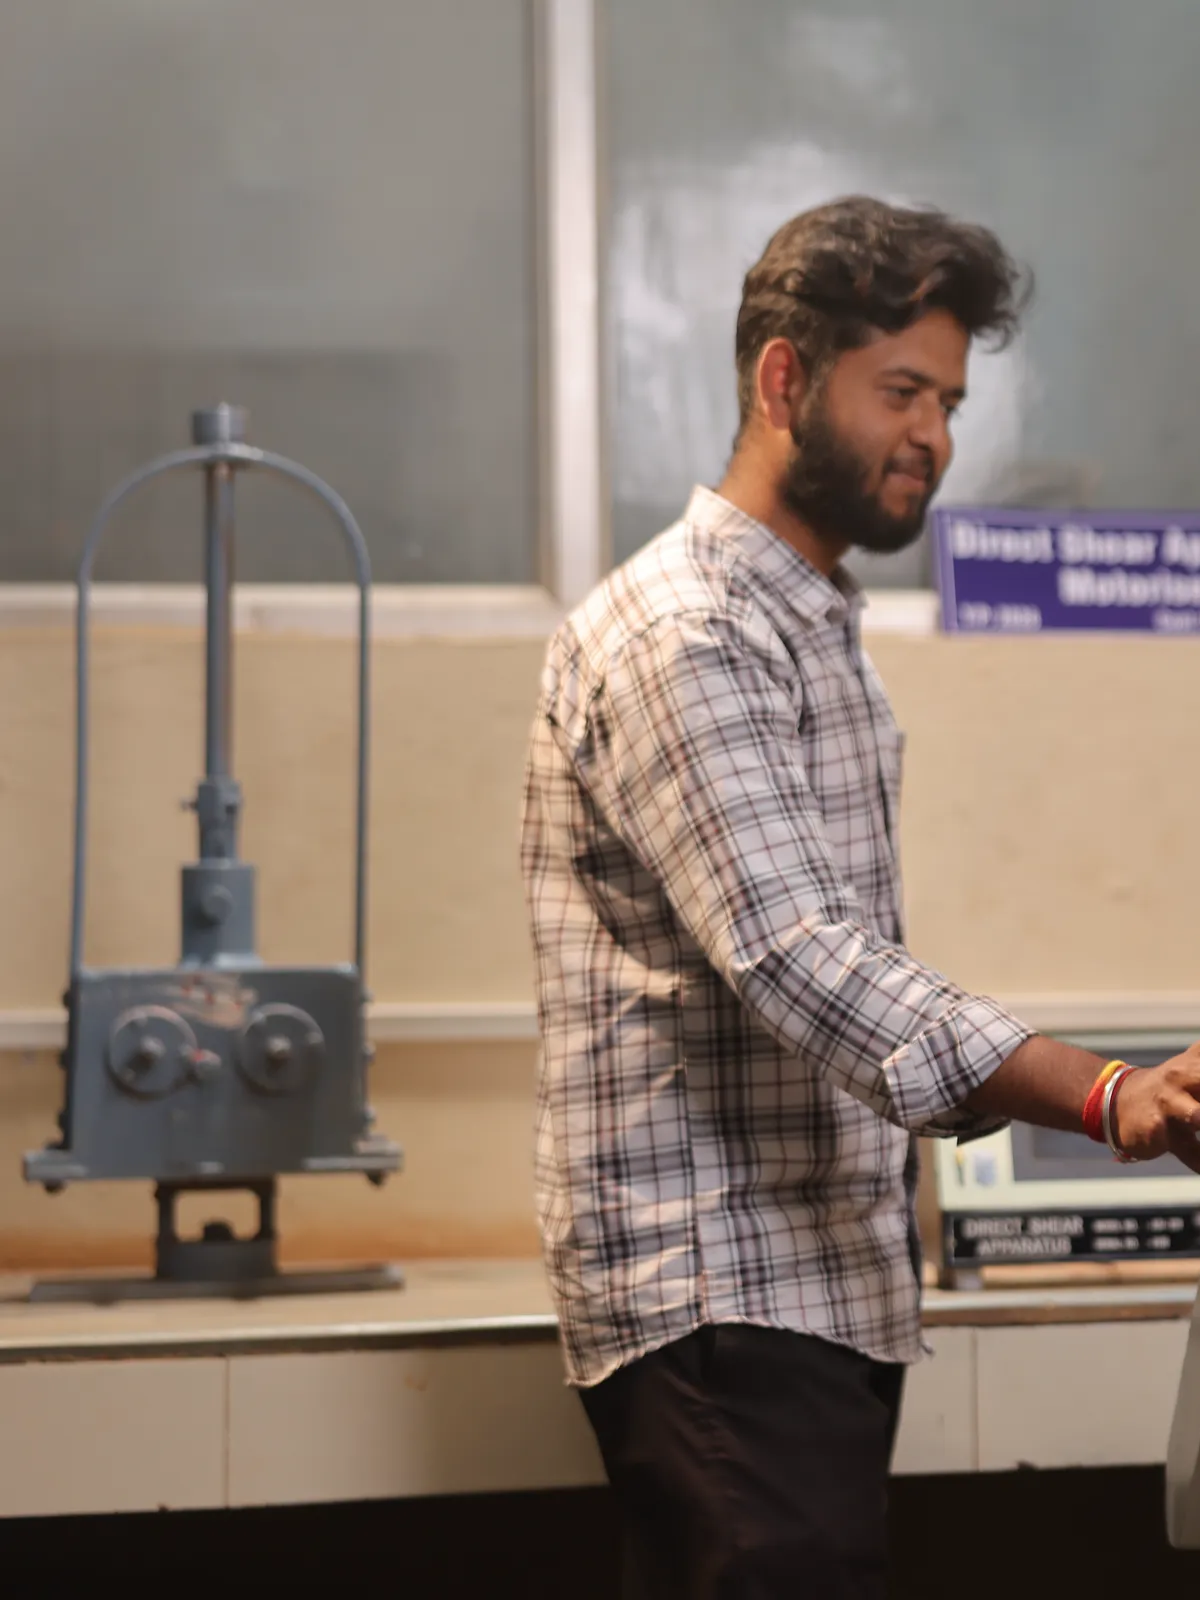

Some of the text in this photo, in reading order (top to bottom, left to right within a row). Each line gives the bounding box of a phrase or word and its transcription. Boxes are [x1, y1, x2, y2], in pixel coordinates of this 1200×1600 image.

[954, 520, 1054, 562] Direct
[1058, 523, 1156, 564] Shear
[963, 1219, 1023, 1238] DIRECT
[1028, 1216, 1084, 1236] SHEAR
[977, 1236, 1071, 1256] APPARATUS
